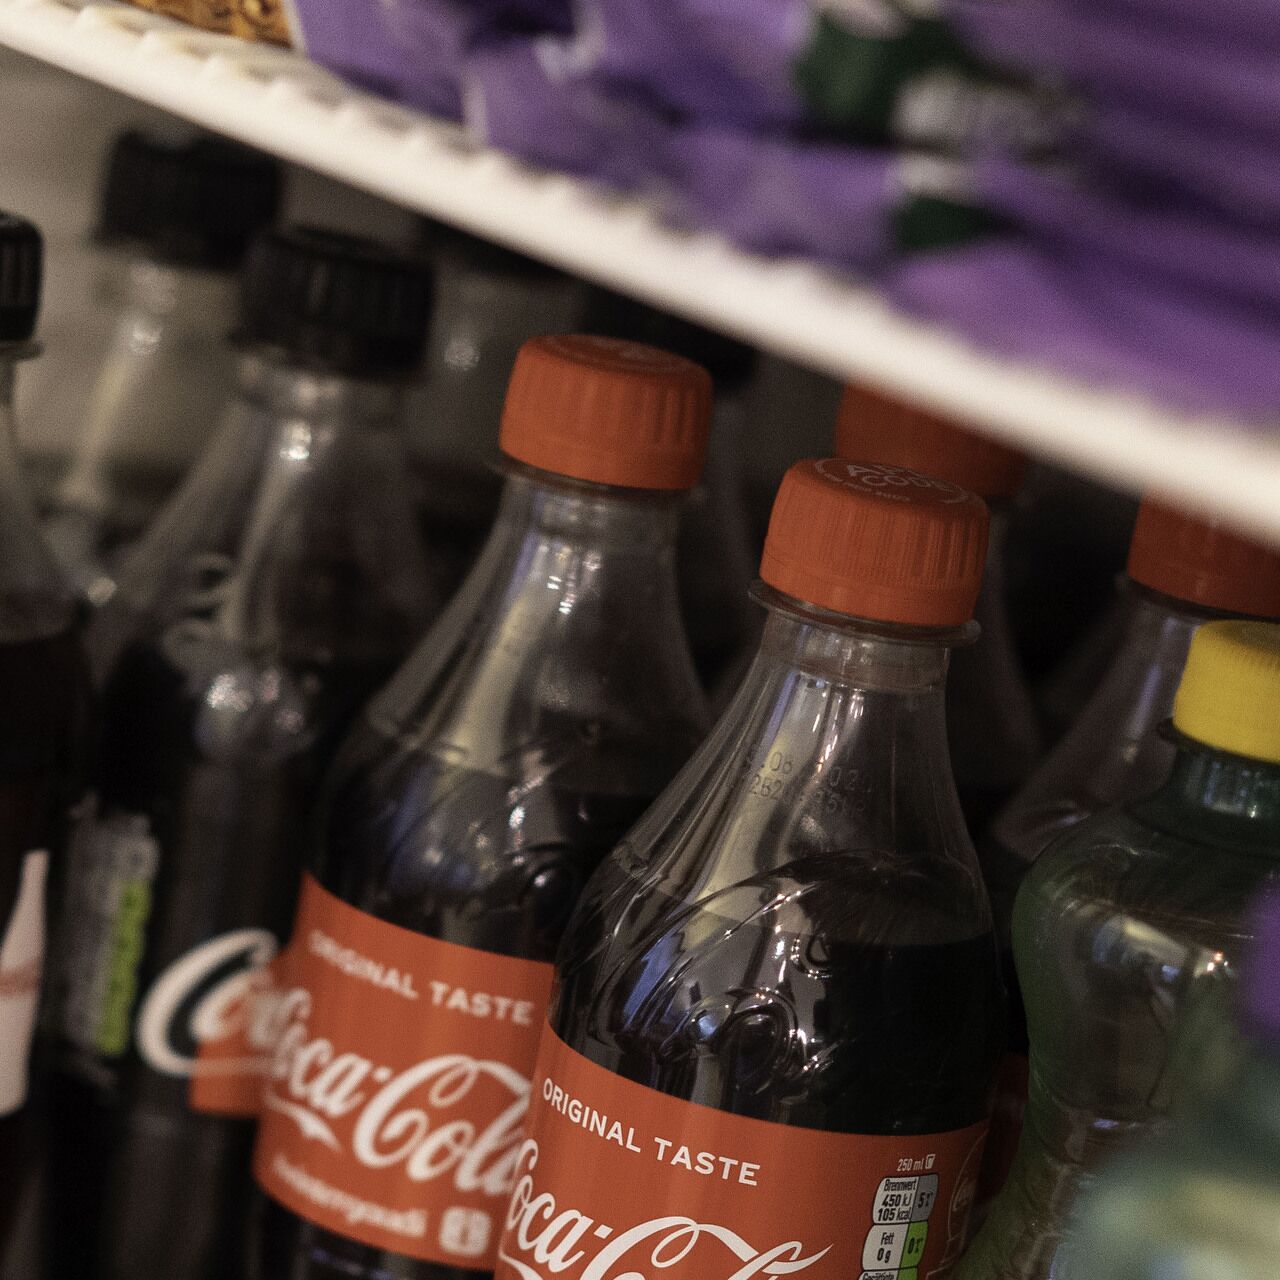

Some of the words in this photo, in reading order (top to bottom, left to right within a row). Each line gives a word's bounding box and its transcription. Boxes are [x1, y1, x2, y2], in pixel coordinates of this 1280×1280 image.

[428, 980, 535, 1025] TASTE
[543, 1078, 641, 1153] ORIGINAL
[654, 1137, 761, 1187] TASTE
[896, 1158, 913, 1172] 250
[884, 1179, 917, 1192] Brennwert
[881, 1194, 901, 1207] 450
[878, 1208, 895, 1221] 105
[896, 1207, 911, 1220] kcal
[881, 1232, 894, 1245] Fett
